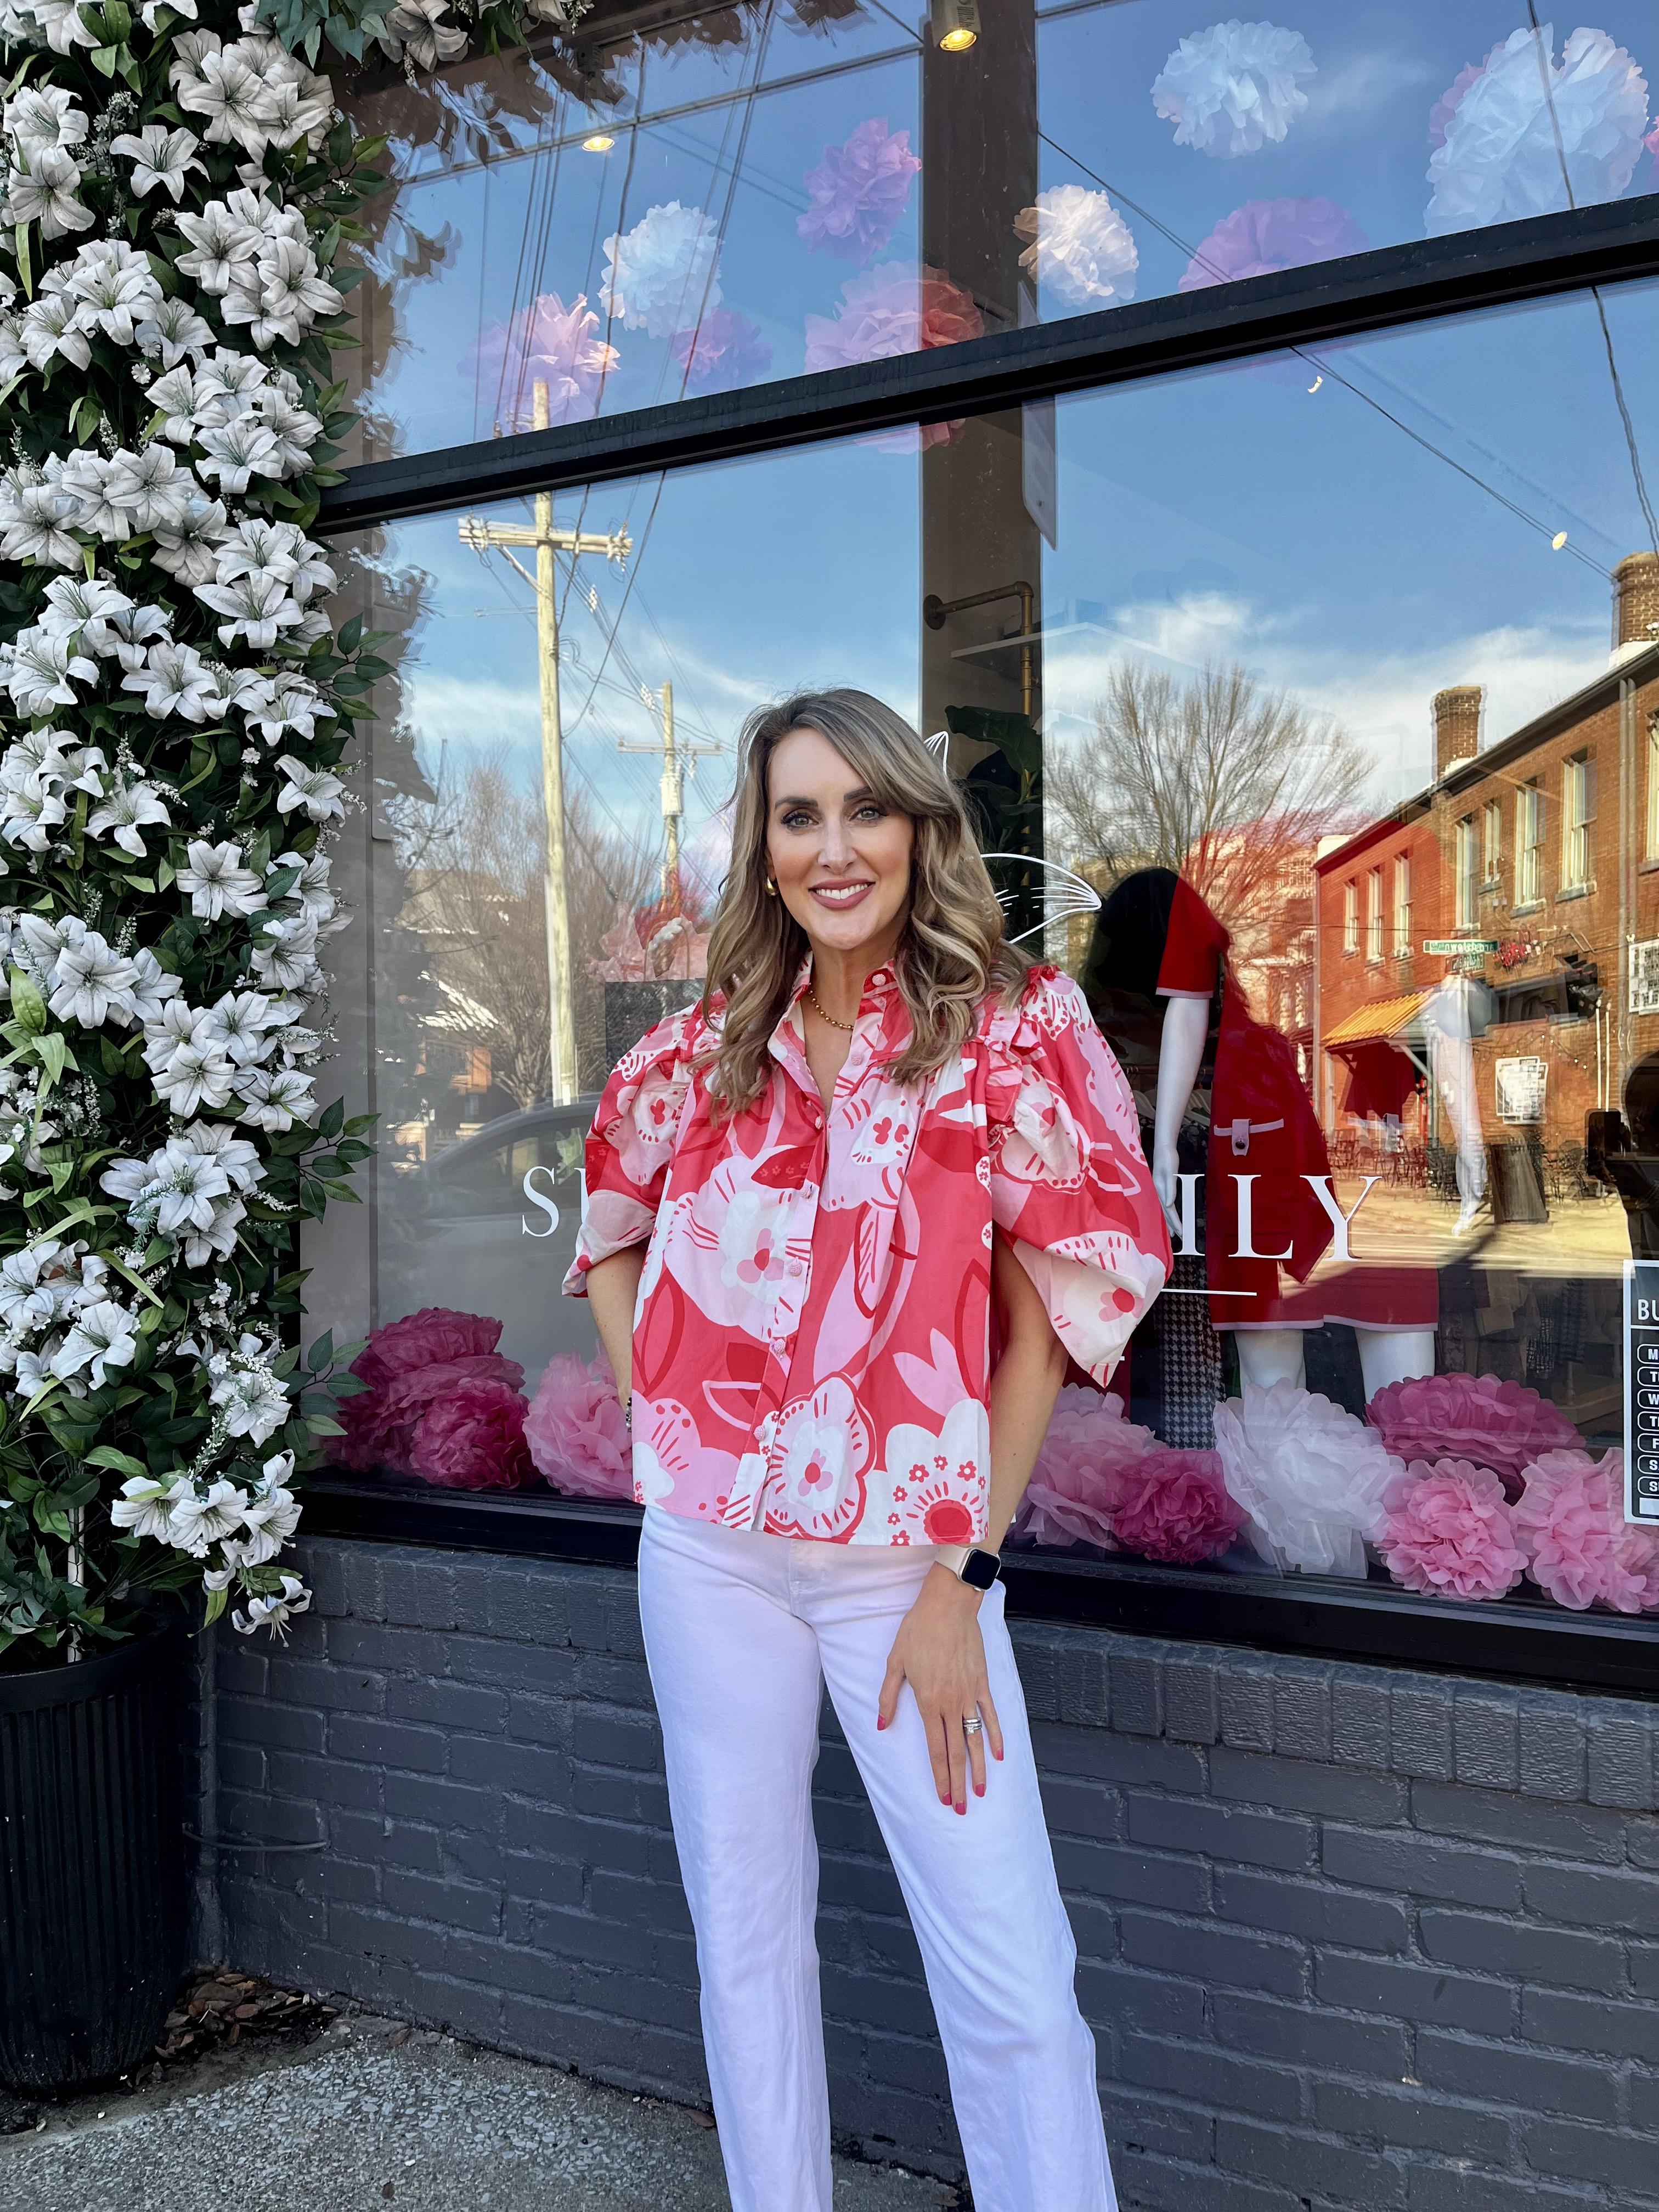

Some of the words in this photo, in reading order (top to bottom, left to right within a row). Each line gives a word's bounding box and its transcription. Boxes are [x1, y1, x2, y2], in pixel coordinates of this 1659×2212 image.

[1650, 1371, 1659, 1383] T
[1649, 1415, 1659, 1427] T
[1649, 1459, 1659, 1471] S
[1649, 1481, 1659, 1492] S
